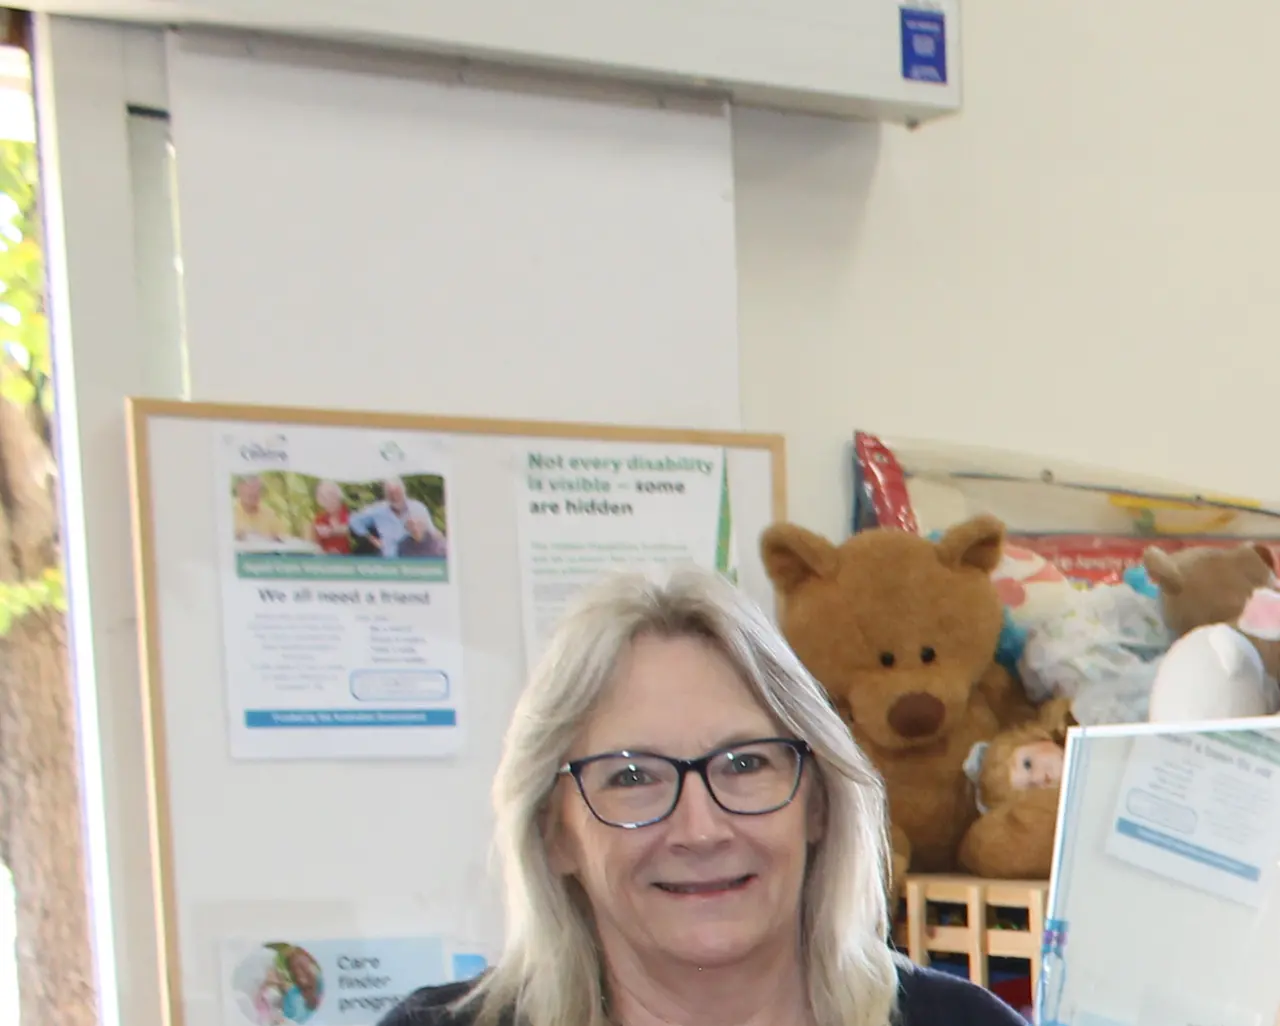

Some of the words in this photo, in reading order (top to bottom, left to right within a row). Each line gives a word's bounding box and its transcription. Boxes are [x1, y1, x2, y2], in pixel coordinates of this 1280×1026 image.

[527, 453, 563, 469] Not
[568, 455, 621, 473] every
[627, 455, 714, 474] disability
[527, 474, 543, 491] is
[549, 476, 611, 492] visible
[636, 480, 685, 493] some
[529, 501, 559, 514] are
[565, 499, 633, 515] hidden
[257, 588, 286, 603] We
[293, 589, 312, 603] all
[317, 589, 360, 604] need
[379, 590, 430, 605] friend
[337, 955, 380, 970] Care
[338, 973, 391, 989] finder
